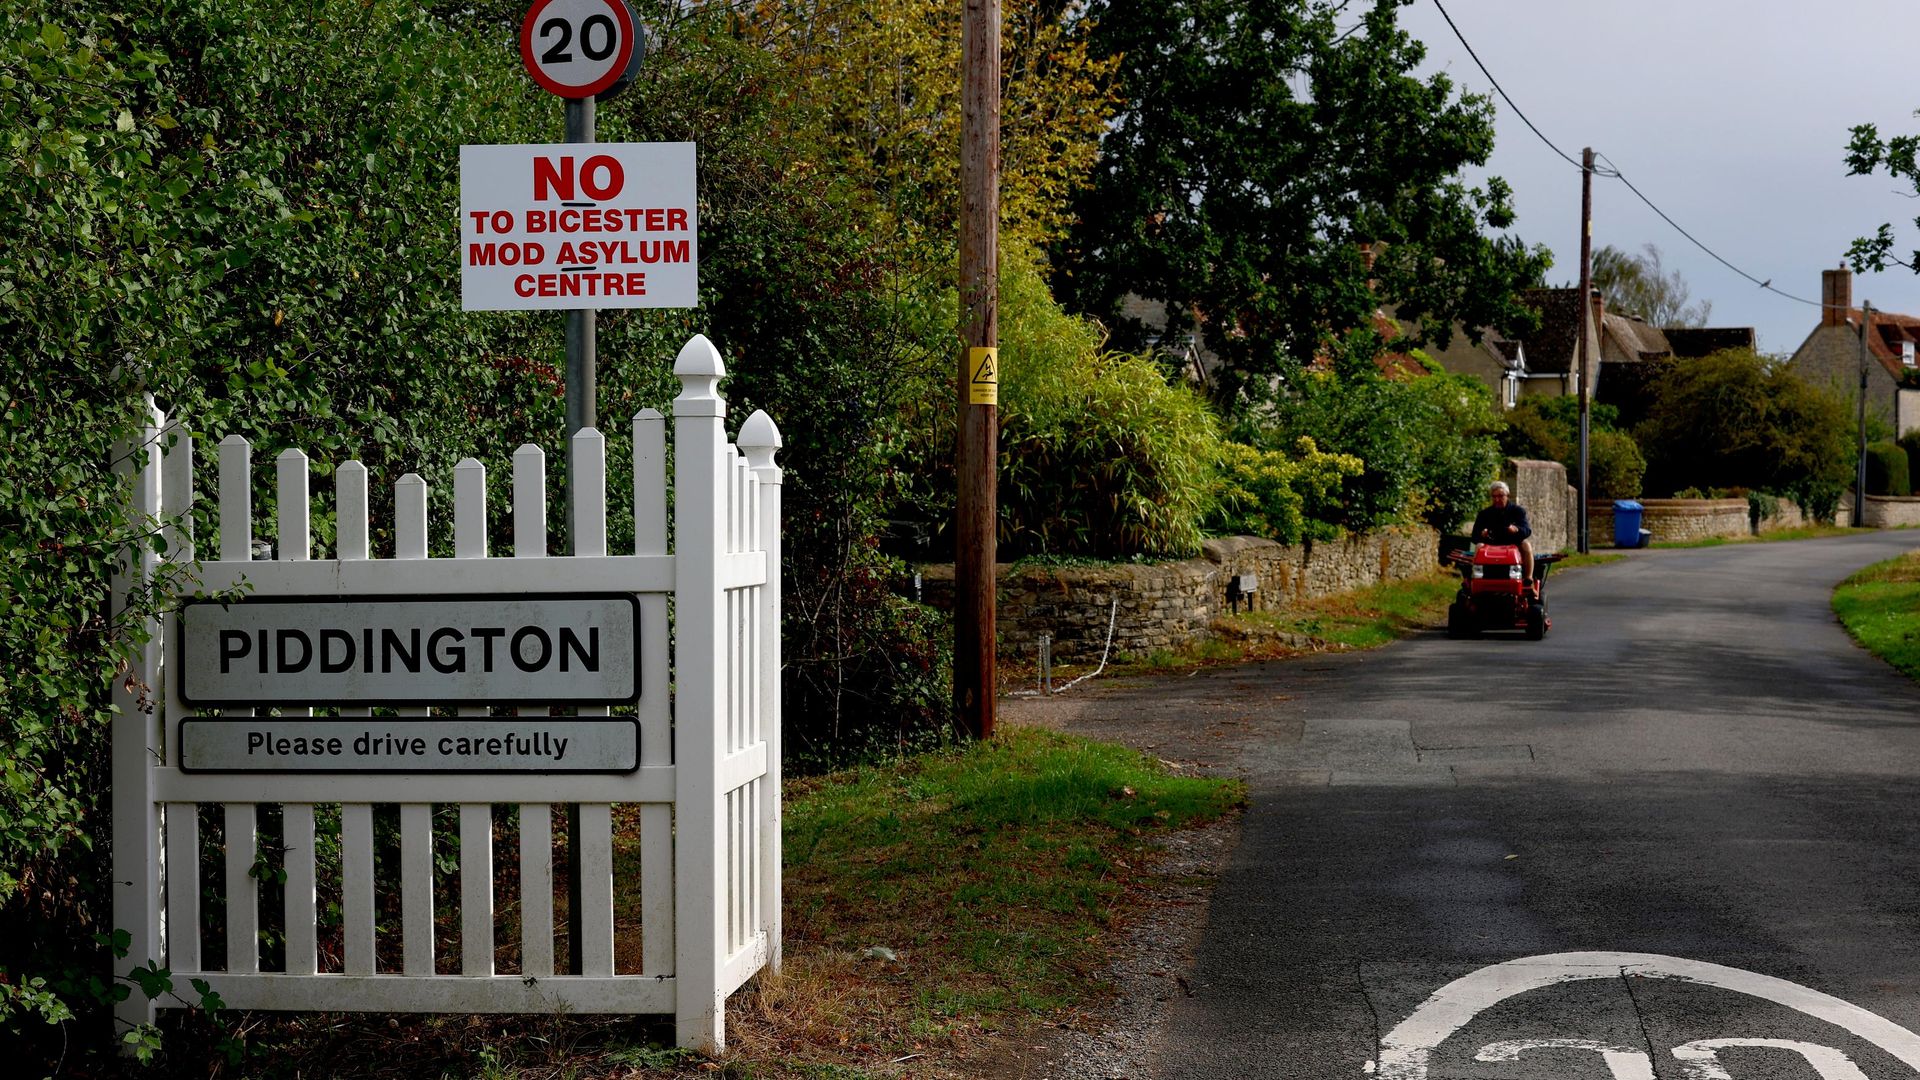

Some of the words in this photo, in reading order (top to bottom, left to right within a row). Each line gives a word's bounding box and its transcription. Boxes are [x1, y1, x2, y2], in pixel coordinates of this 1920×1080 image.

[540, 14, 617, 64] 20
[534, 155, 625, 201] NO
[470, 211, 515, 234] TO
[526, 208, 689, 233] BICESTER
[469, 242, 545, 266] MOD
[556, 240, 690, 265] ASYLUM
[514, 273, 646, 298] CENTRE
[219, 625, 600, 674] PIDDINGTON
[247, 732, 343, 756] Please
[354, 732, 427, 756] drive
[438, 732, 569, 761] carefully
